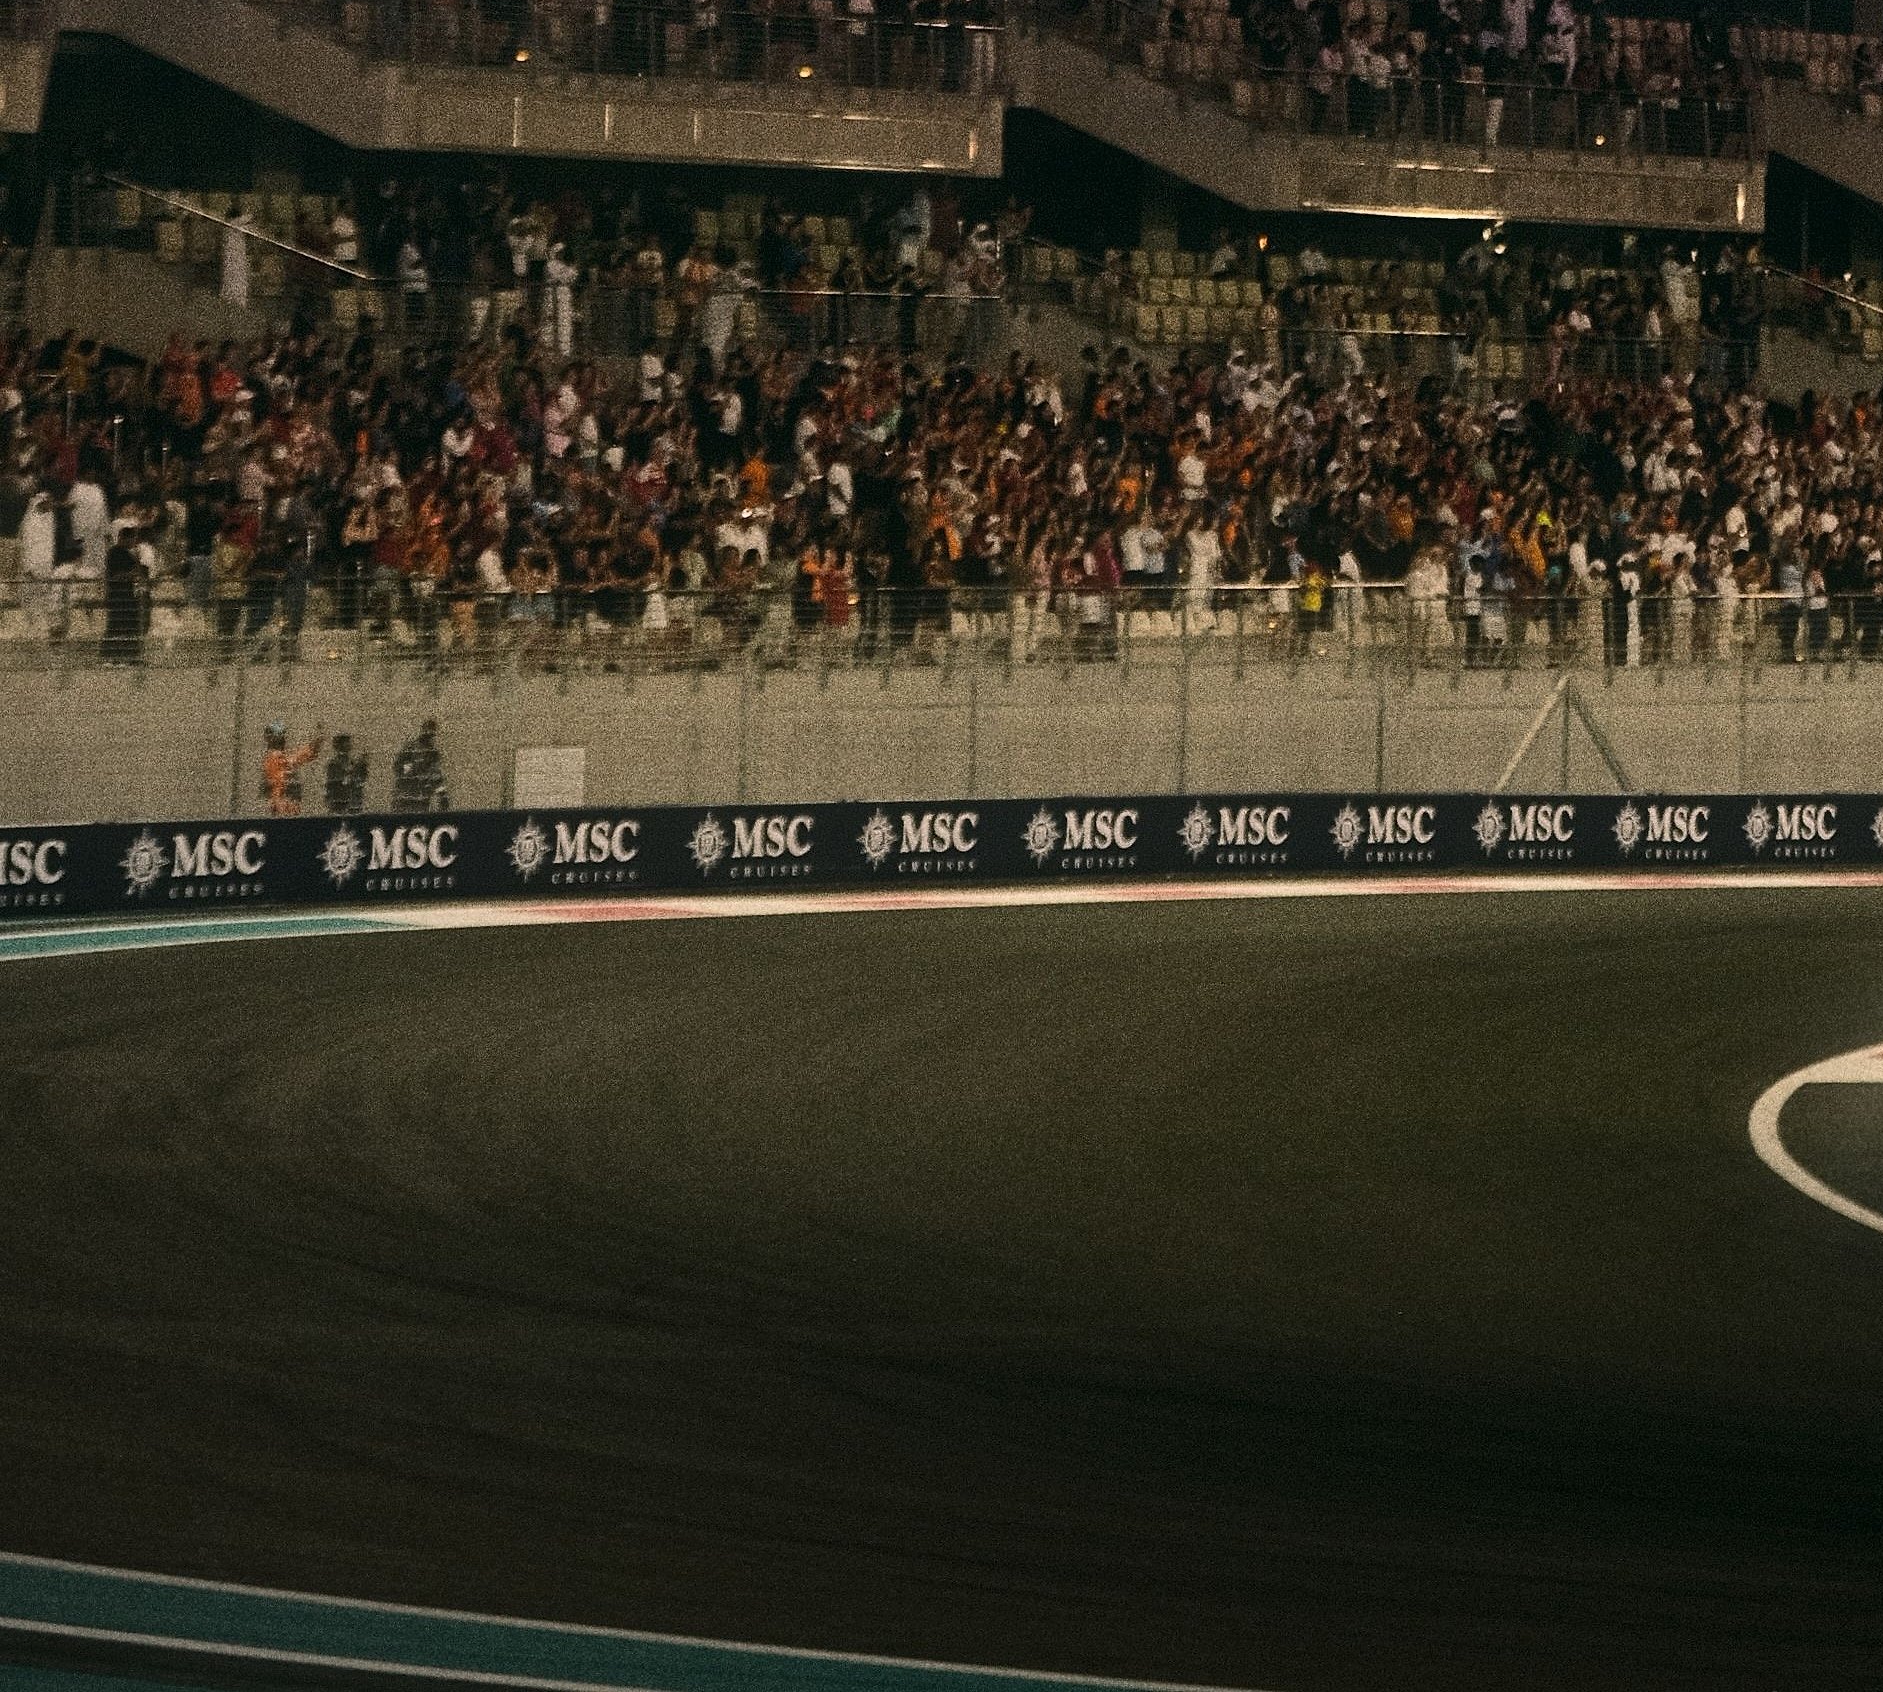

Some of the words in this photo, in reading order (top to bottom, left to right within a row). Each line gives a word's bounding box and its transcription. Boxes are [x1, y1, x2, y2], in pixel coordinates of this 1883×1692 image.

[732, 816, 813, 858] MSC
[901, 812, 977, 852] MSC
[1064, 810, 1137, 849] MSC
[1218, 807, 1289, 845] MSC
[1368, 806, 1434, 843] MSC
[1509, 805, 1573, 841] MSC
[1647, 806, 1709, 842] MSC
[1776, 805, 1836, 840] MSC
[172, 832, 265, 877] MSC
[368, 826, 457, 869] MSC
[554, 821, 639, 863] MSC
[1216, 853, 1286, 863] CRUISES
[730, 865, 810, 877] CRUISES
[898, 860, 974, 872] CRUISES
[1062, 857, 1135, 868] CRUISES
